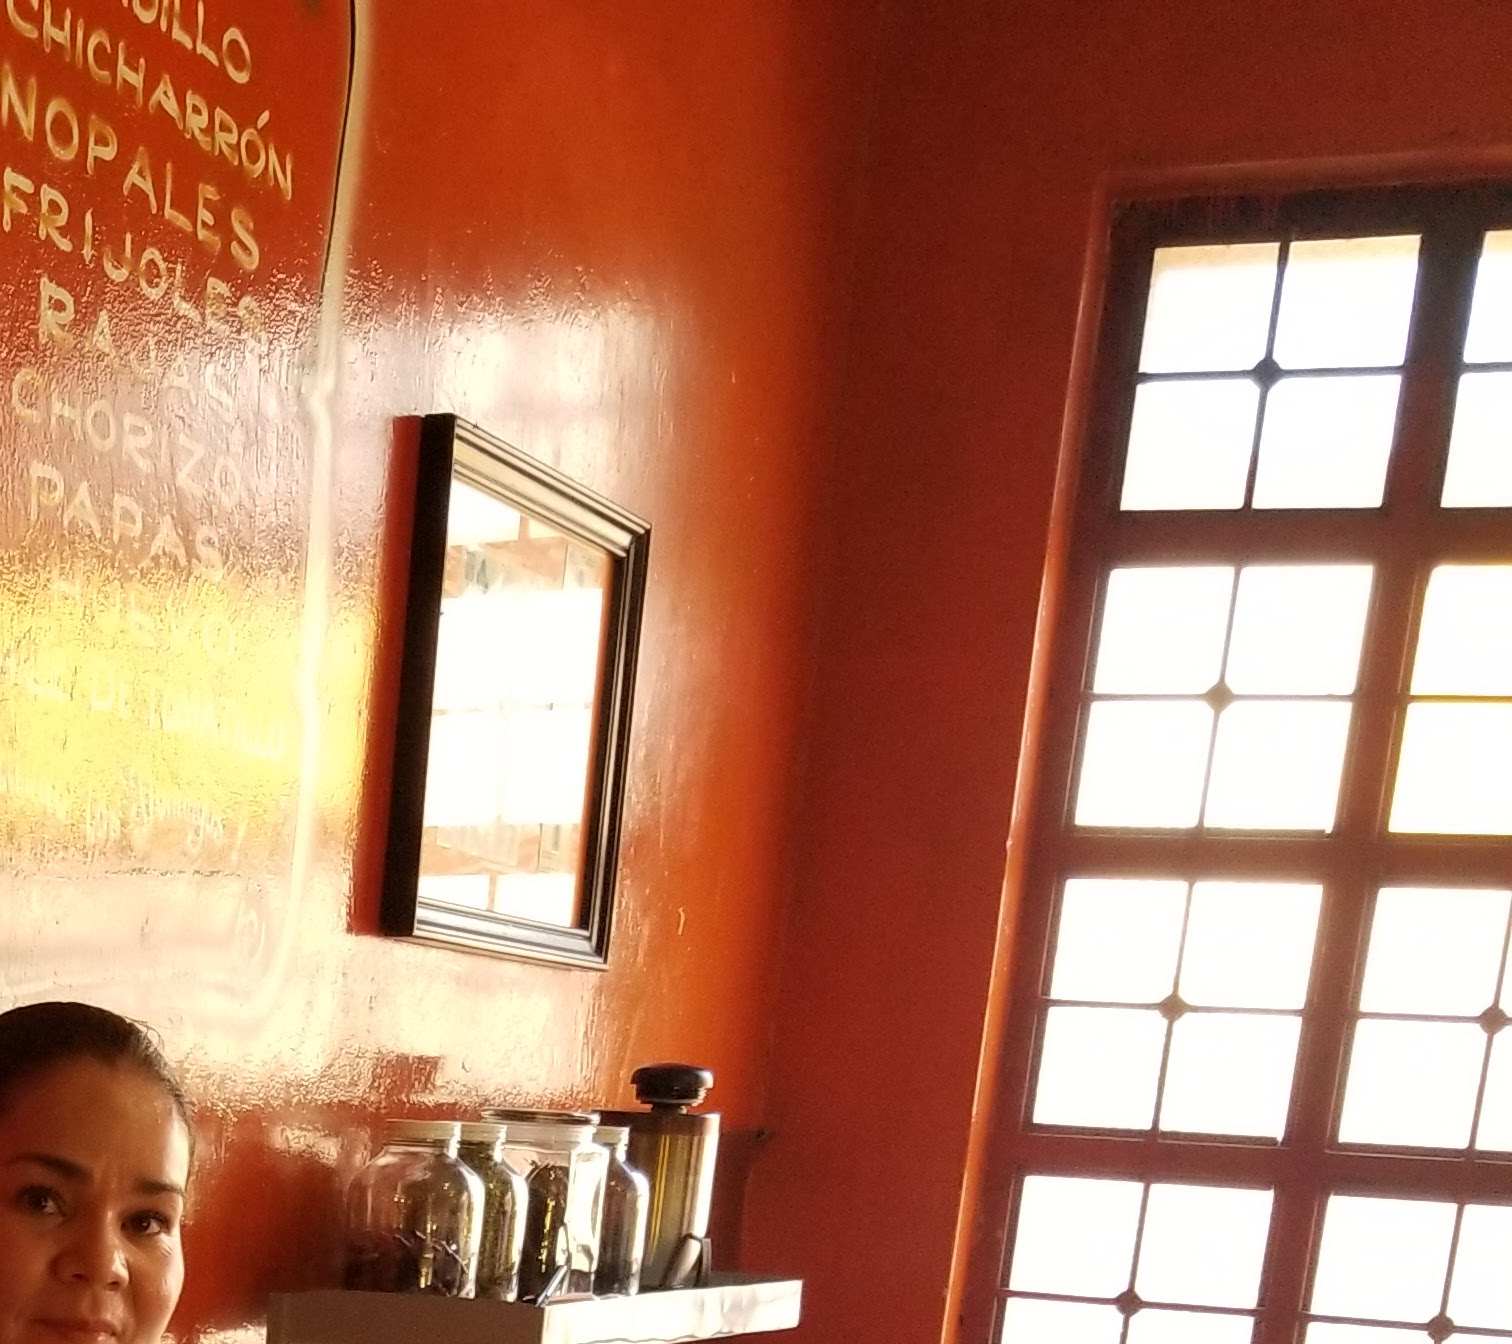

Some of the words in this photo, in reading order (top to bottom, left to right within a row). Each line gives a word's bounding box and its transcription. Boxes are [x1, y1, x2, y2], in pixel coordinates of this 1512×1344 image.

[1, 63, 260, 271] NOPALES
[6, 0, 292, 201] CHICHARRÓN
[2, 165, 266, 354] FRIJOLES
[11, 367, 241, 504] CHORIZO
[29, 459, 224, 581] PAPAS
